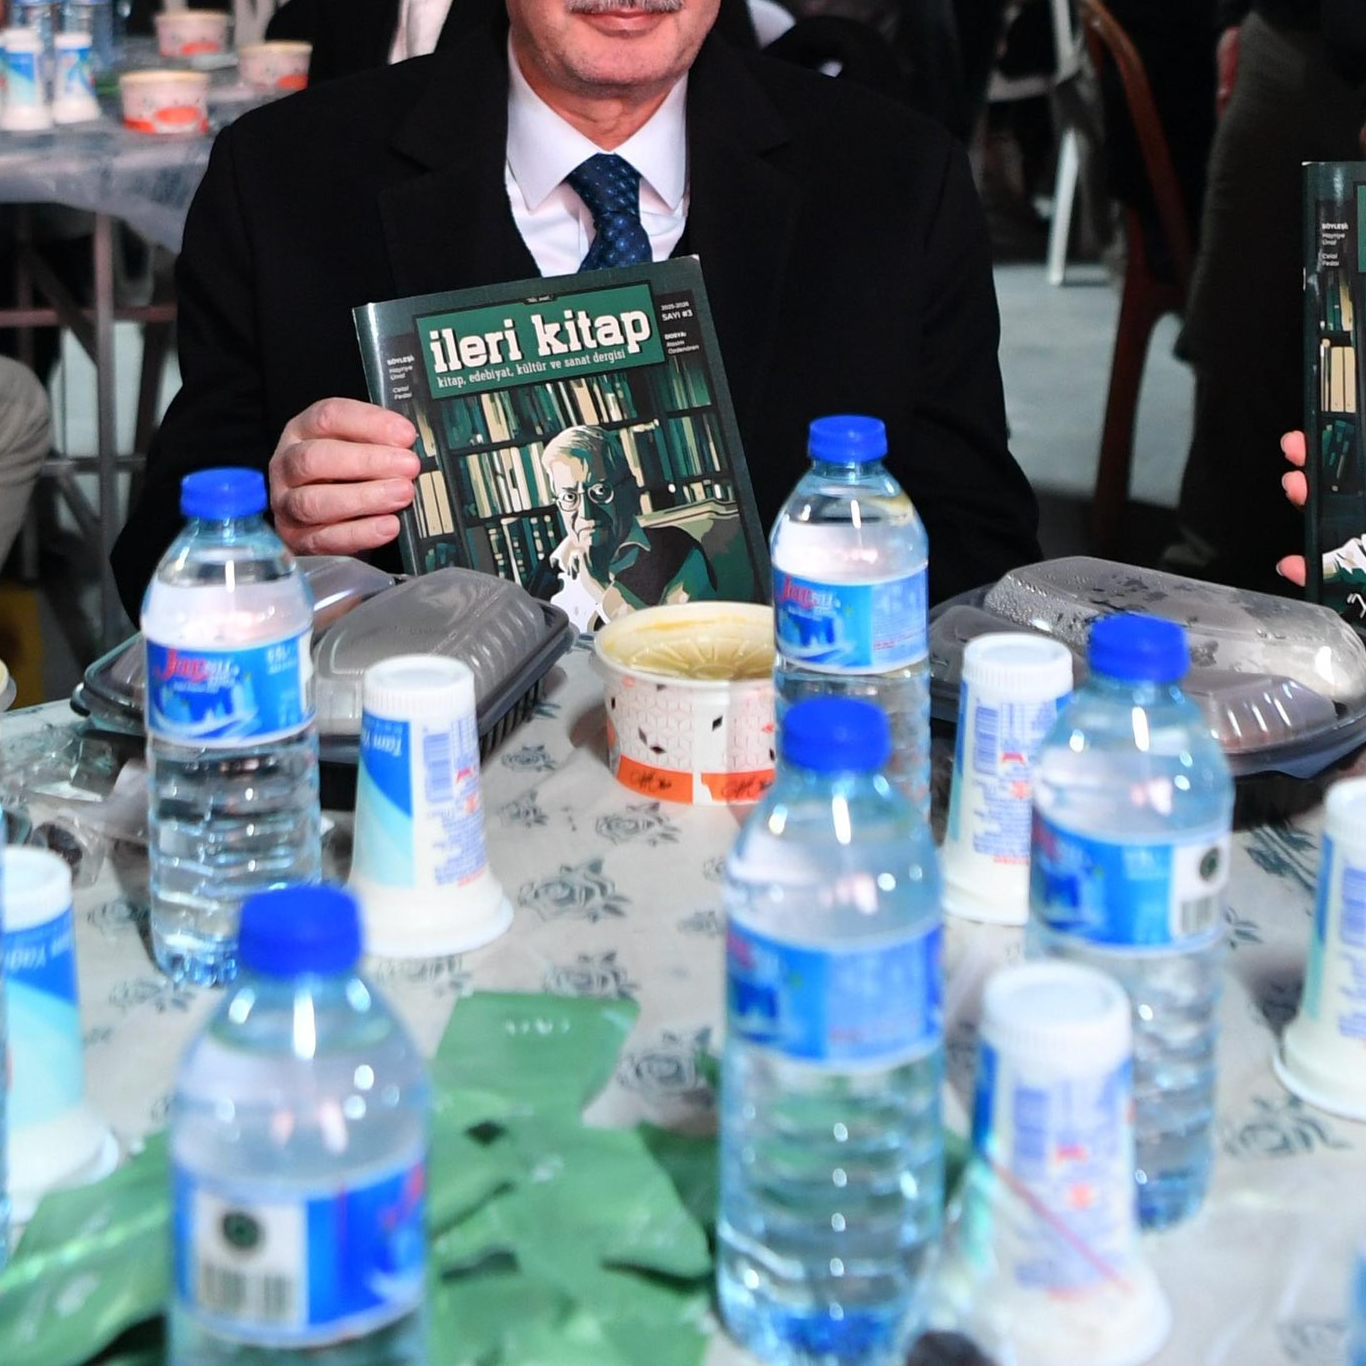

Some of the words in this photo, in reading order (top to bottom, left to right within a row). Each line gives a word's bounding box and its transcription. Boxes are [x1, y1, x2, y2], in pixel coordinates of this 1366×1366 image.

[662, 311, 681, 321] SAYI
[429, 318, 523, 374] ileri
[531, 309, 651, 355] kitap
[437, 375, 466, 388] kitap,
[469, 367, 514, 384] edebiyat,
[516, 361, 547, 375] kültür
[550, 361, 562, 369] ve
[564, 355, 590, 368] sanat
[592, 349, 626, 364] dergisi
